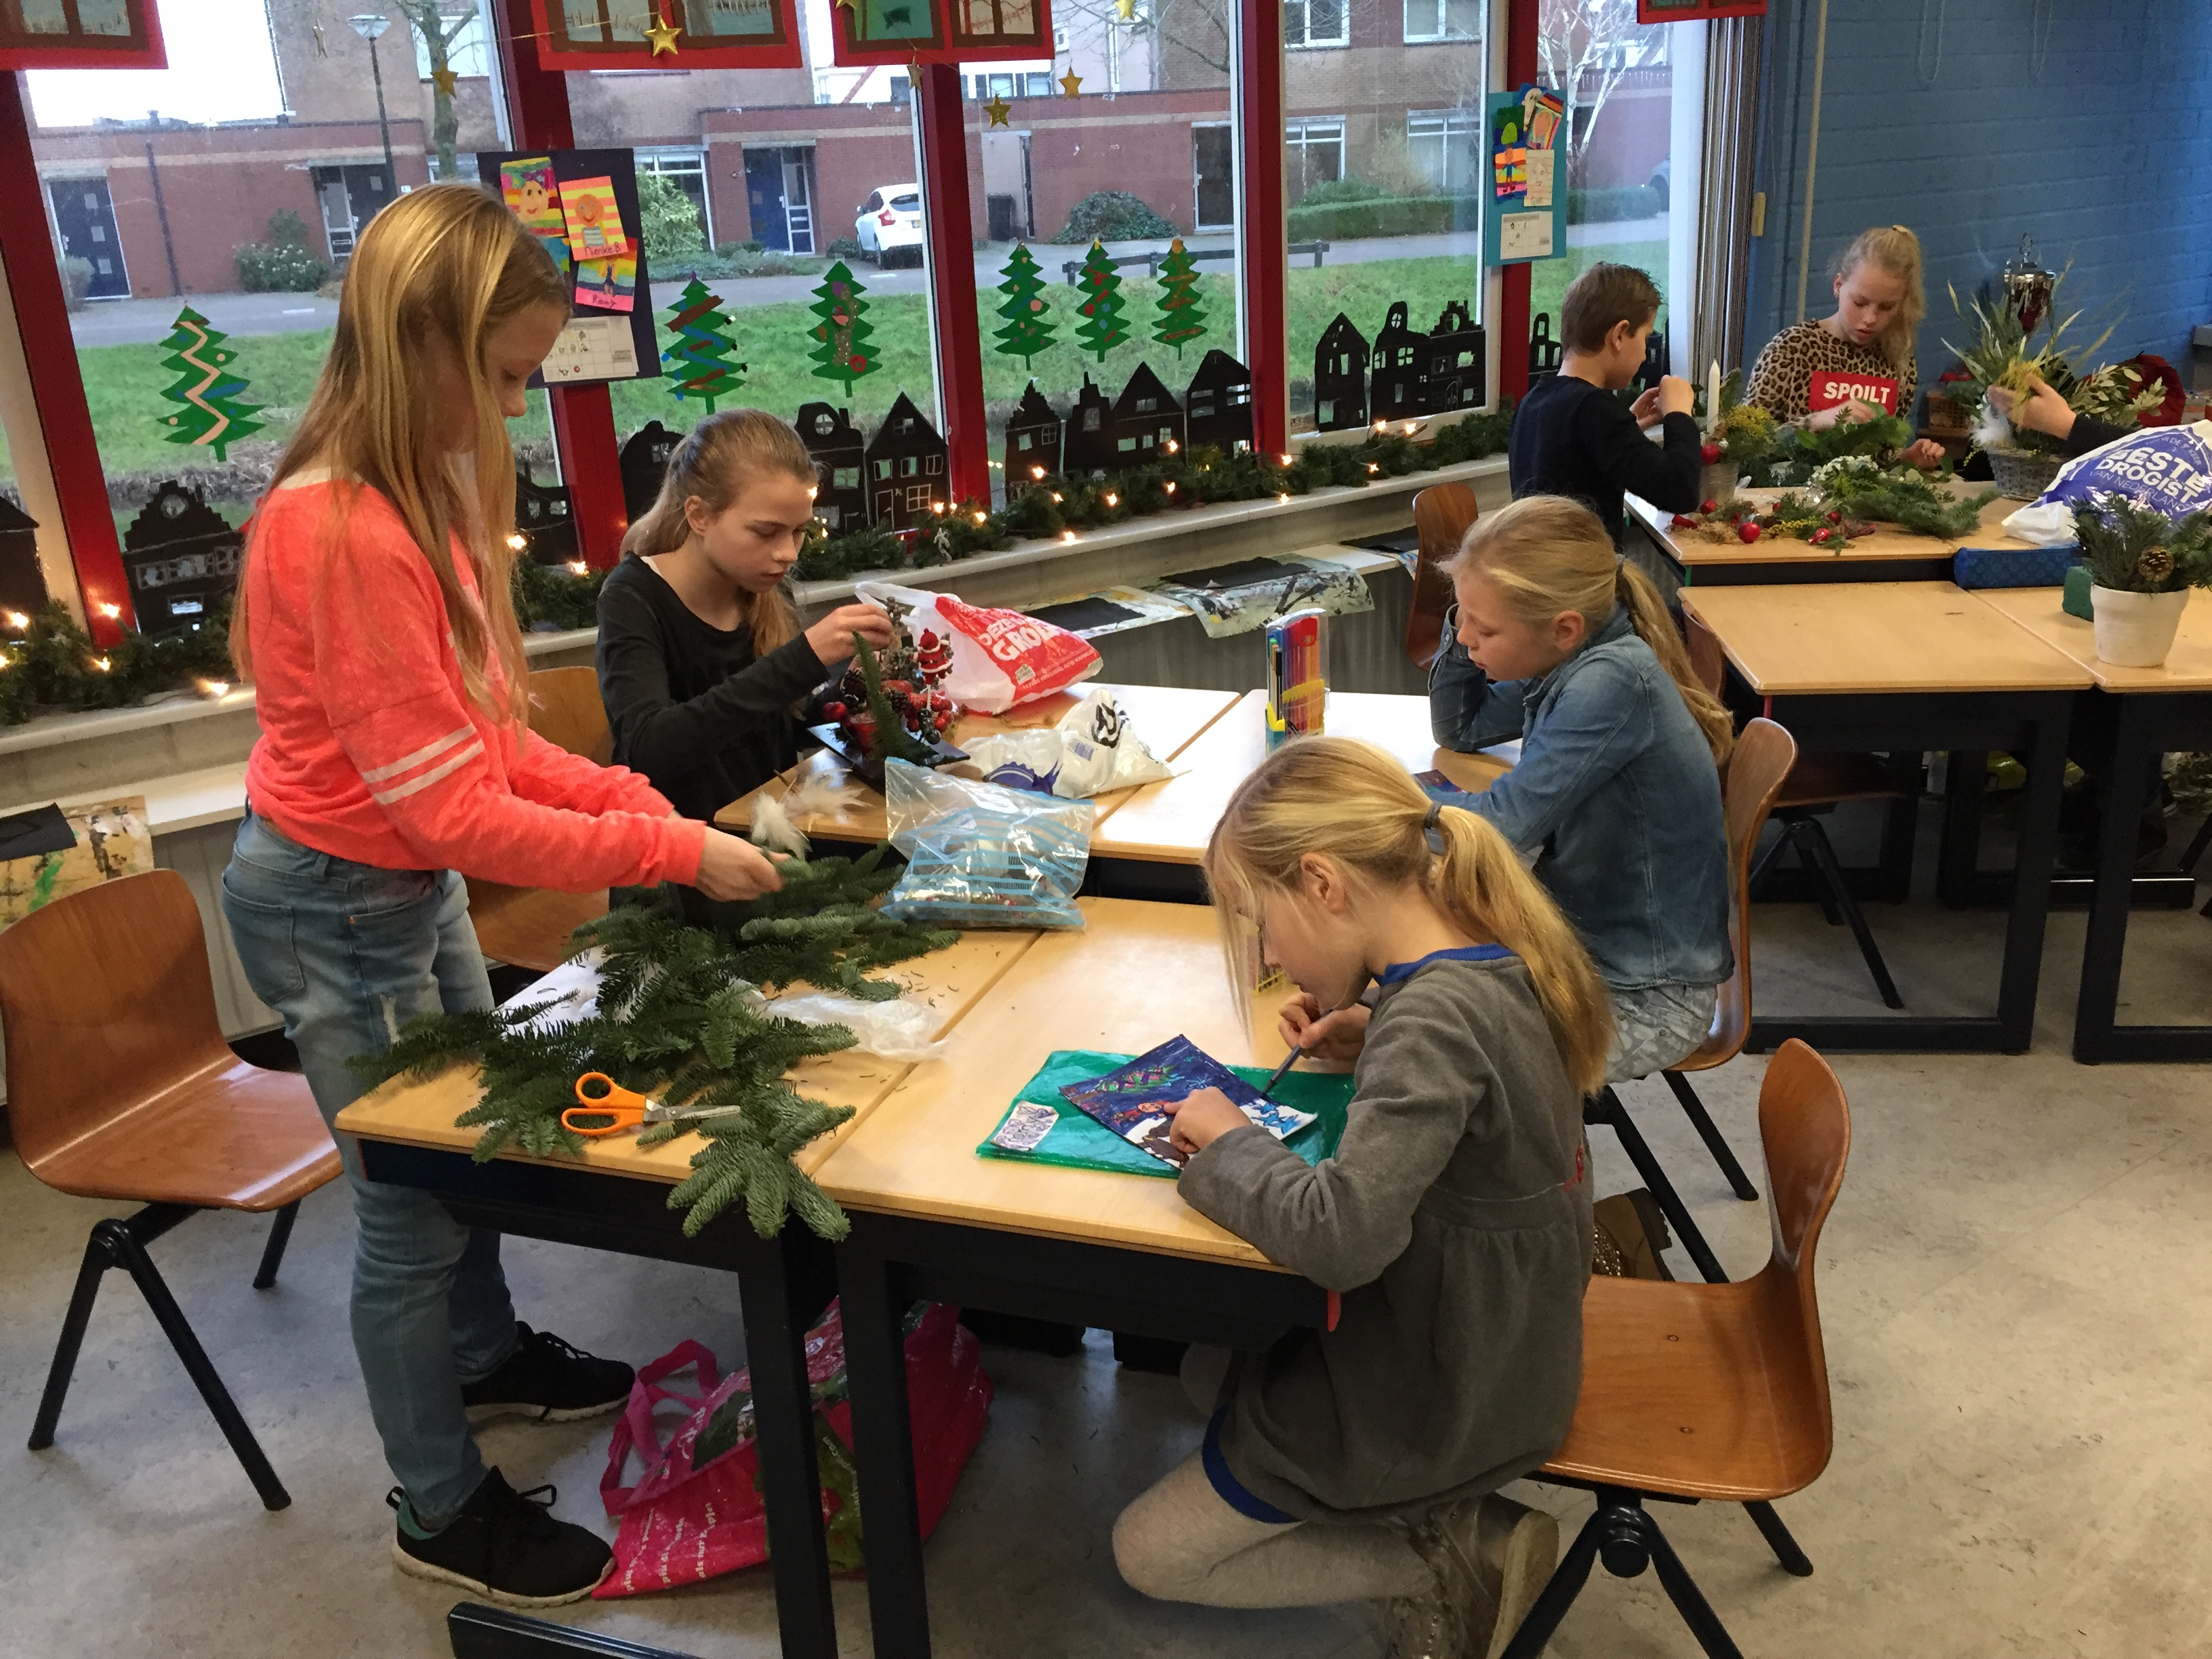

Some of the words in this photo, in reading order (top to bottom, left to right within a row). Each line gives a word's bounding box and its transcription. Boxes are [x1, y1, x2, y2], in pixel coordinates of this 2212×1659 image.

[1823, 381, 1891, 404] SPOILT
[2095, 458, 2198, 504] DROGIST
[2105, 447, 2205, 493] BESTE
